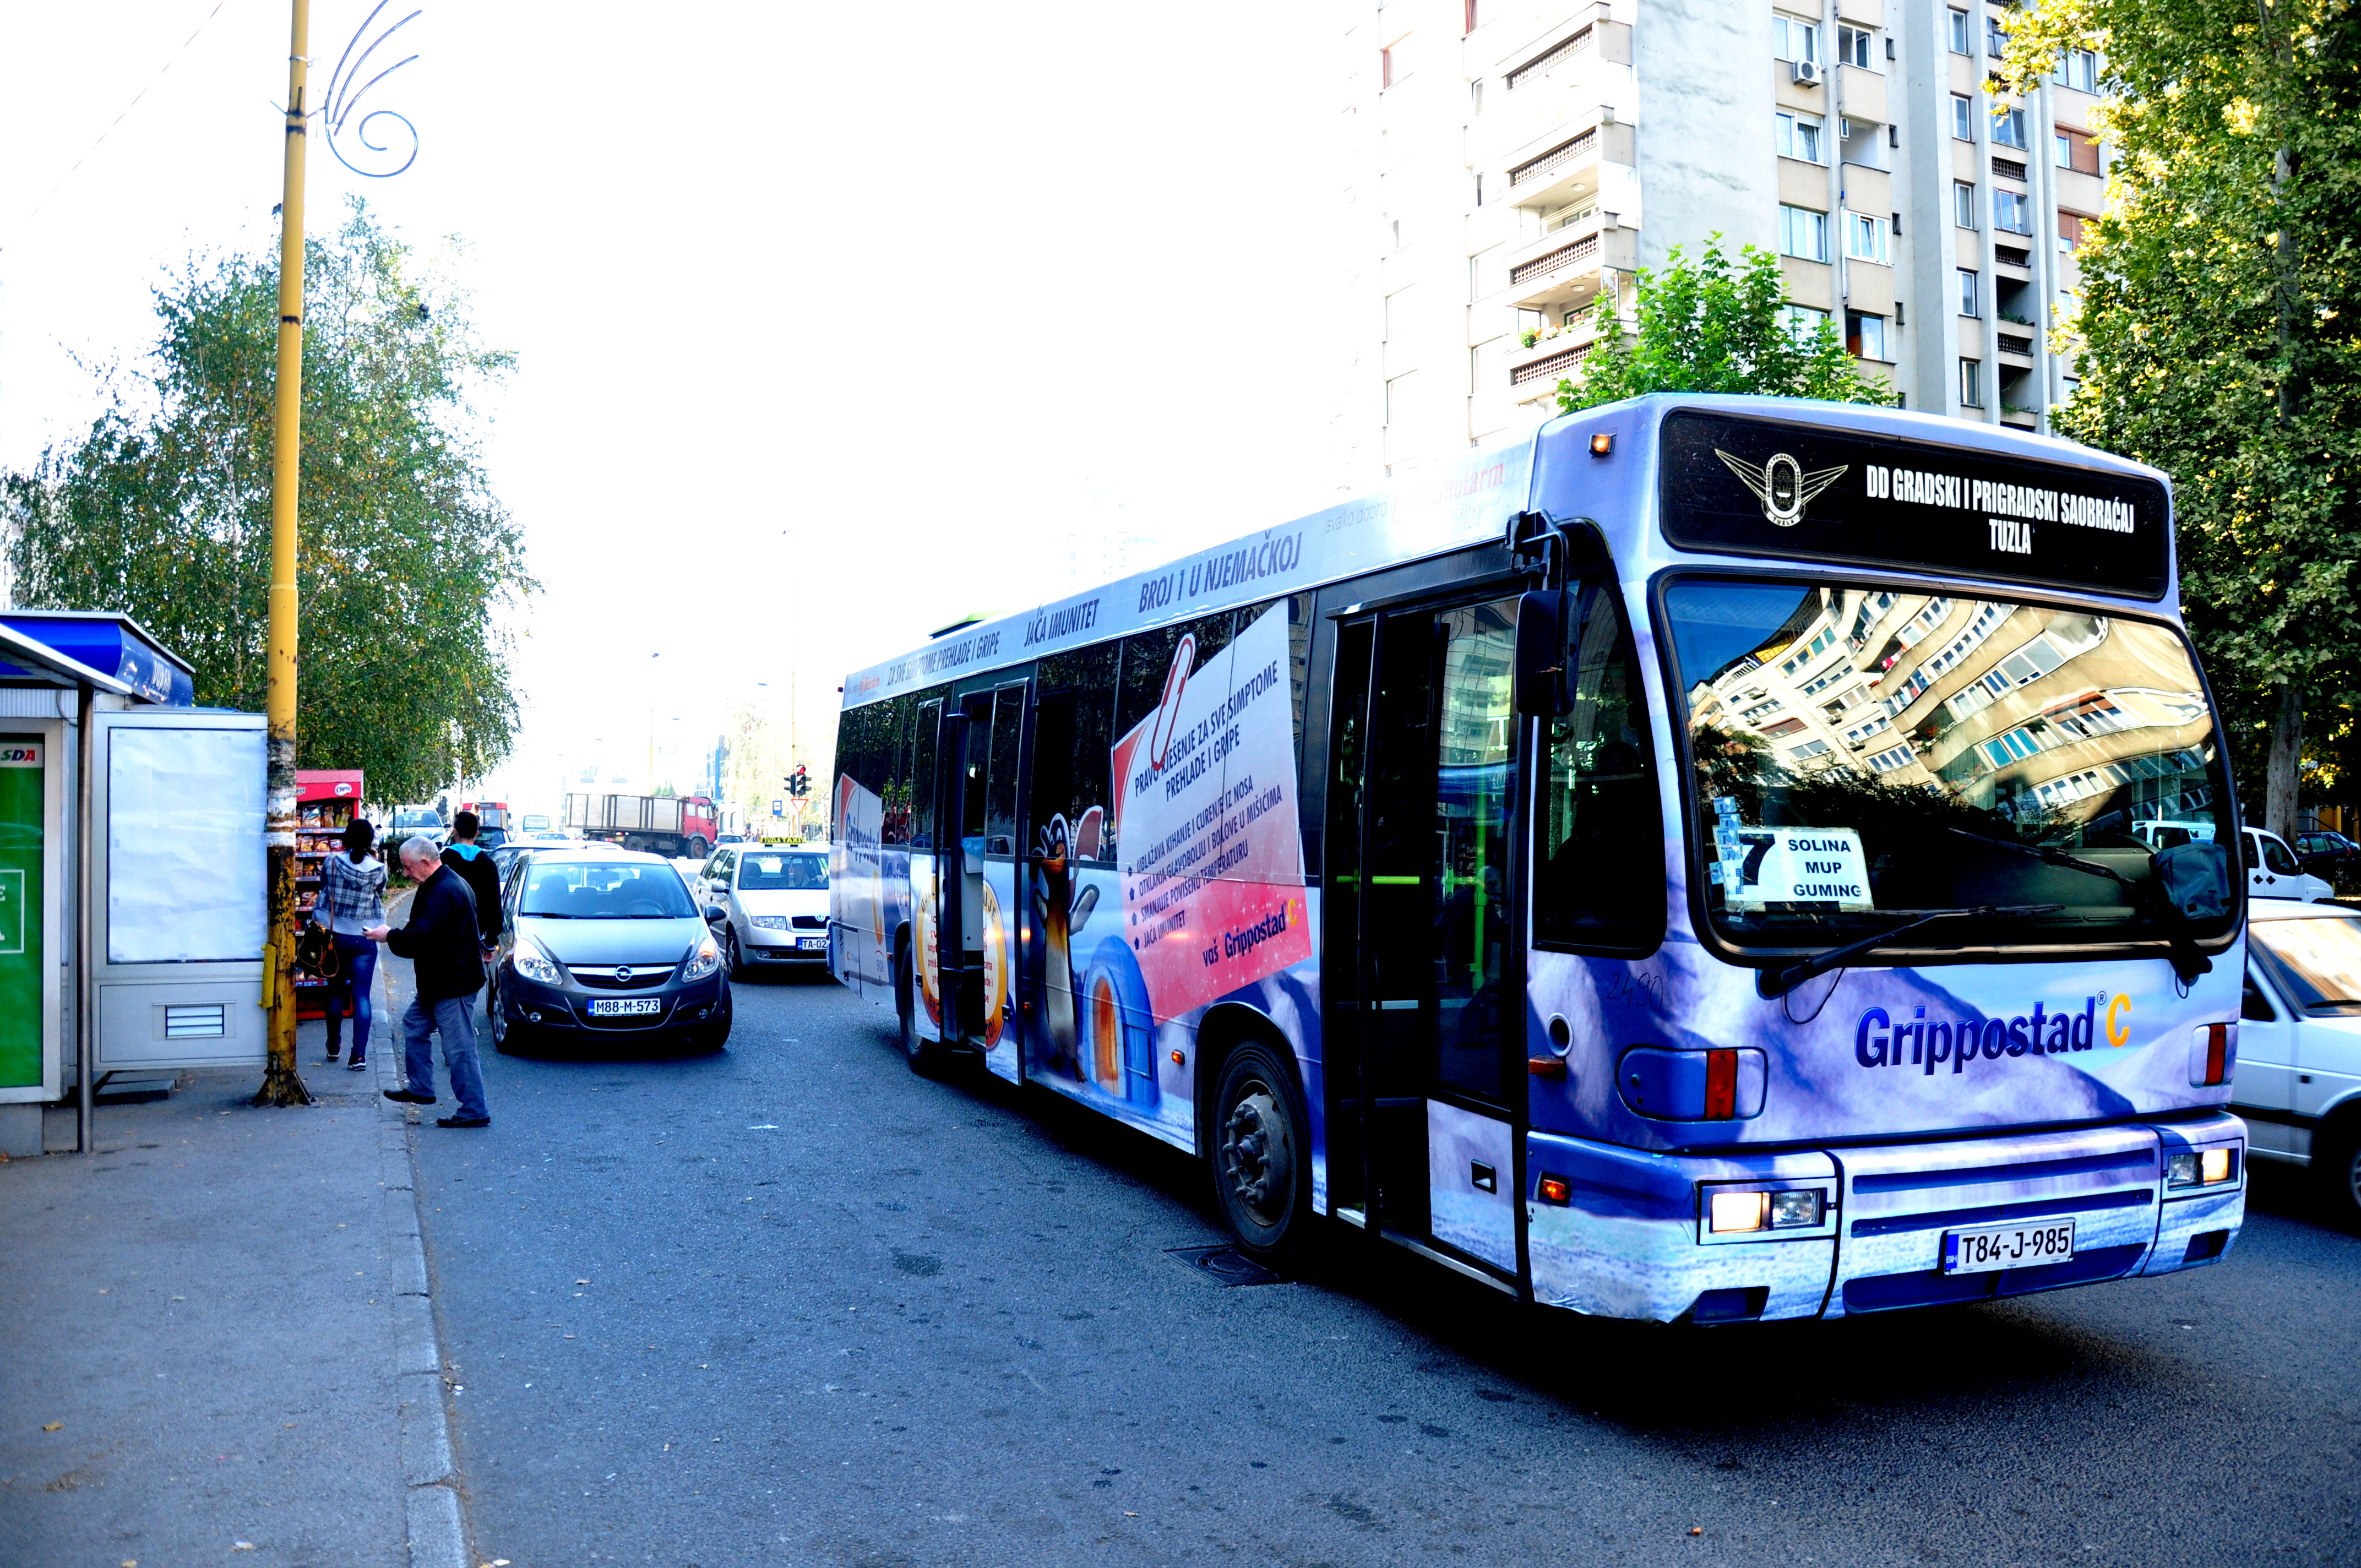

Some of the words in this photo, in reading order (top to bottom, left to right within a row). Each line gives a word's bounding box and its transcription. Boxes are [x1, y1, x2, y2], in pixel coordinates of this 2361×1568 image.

[1325, 509, 1354, 533] svako
[1357, 502, 1388, 524] dobro
[1773, 516, 1794, 526] TUZLA
[1867, 465, 1889, 499] DD
[1892, 468, 1961, 508] GRADSKI
[1963, 478, 1970, 510] I
[1972, 479, 2059, 522] PRIGRADSKI
[2060, 492, 2135, 533] SAOBRAĆAJ
[1988, 518, 2032, 554] TUZLA
[1138, 573, 1174, 613] BROJ
[1177, 569, 1185, 601] 1
[1189, 563, 1203, 597] U
[1204, 530, 1303, 594] NJEMAČKOJ
[1024, 609, 1047, 647] JAČA
[1047, 598, 1100, 640] IMUNITET
[887, 665, 895, 687] ZA
[895, 662, 907, 684] SVE
[905, 651, 938, 680] SIMPTOME
[936, 640, 972, 672] PREHLADE
[971, 639, 976, 661] I
[976, 631, 1000, 660] GRIPE
[1135, 761, 1159, 798] PRAVO
[1162, 729, 1195, 776] RJEŠENJE
[1198, 719, 1209, 747] ZA
[1211, 703, 1226, 736] SVE
[1228, 660, 1278, 721] SIMPTOME
[0, 749, 35, 761] SDA
[1166, 751, 1206, 802] PREHLADE
[1208, 747, 1211, 769] I
[1214, 723, 1240, 763] GRIPE
[1136, 842, 1166, 874] UBLAŽAVA
[1166, 821, 1191, 854] KIHANJE
[1193, 818, 1195, 835] I
[1196, 796, 1223, 831] CURENJE
[1225, 790, 1232, 810] IZ
[1234, 775, 1254, 804] NOSA
[1166, 840, 1206, 878] GLAVOBOLJU
[1207, 836, 1210, 853] I
[1211, 816, 1238, 850] BOLOVE
[1239, 810, 1245, 829] U
[1247, 784, 1282, 825] MIŠIĆIMA
[1788, 839, 1851, 852] SOLINA
[1141, 892, 1169, 922] SMANJUJE
[1200, 839, 1249, 886] TEMPERATURU
[1805, 862, 1842, 874] MUP
[1793, 884, 1862, 897] GUMING
[1144, 924, 1157, 948] JAČA
[1157, 910, 1185, 940] IMUNITET
[1203, 938, 1219, 967] vaš
[1225, 905, 1286, 958] Grippostad
[1287, 899, 1297, 926] C
[596, 1000, 659, 1012] M88-M-573
[1606, 972, 1664, 1011] 2490
[1853, 995, 2096, 1076] Grippostad
[2106, 992, 2131, 1048] C
[1946, 1255, 1957, 1264] BIH
[1962, 1227, 2070, 1264] T84-J-985
